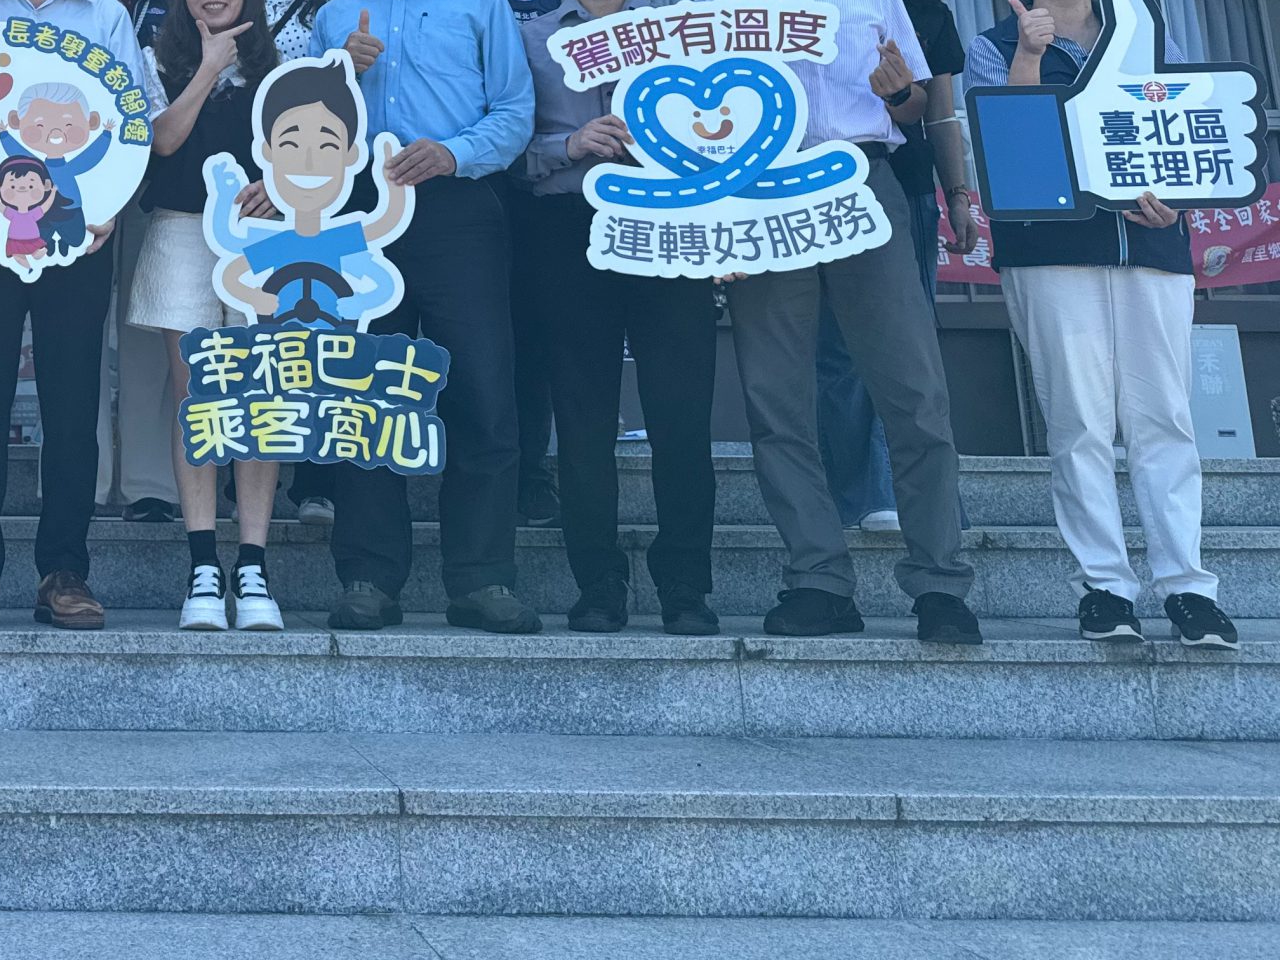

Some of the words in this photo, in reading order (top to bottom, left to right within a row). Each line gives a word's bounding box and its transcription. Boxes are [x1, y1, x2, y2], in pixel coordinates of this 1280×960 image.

[561, 9, 826, 82] 駕駛有溫度
[696, 145, 736, 155] 幸福巴士
[1099, 108, 1229, 146] 臺北區
[1104, 148, 1234, 188] 監理所
[601, 192, 877, 265] 運轉好服務
[1190, 198, 1280, 234] 安全回家
[188, 331, 441, 401] 幸福巴士
[186, 396, 438, 467] 乘客窩心
